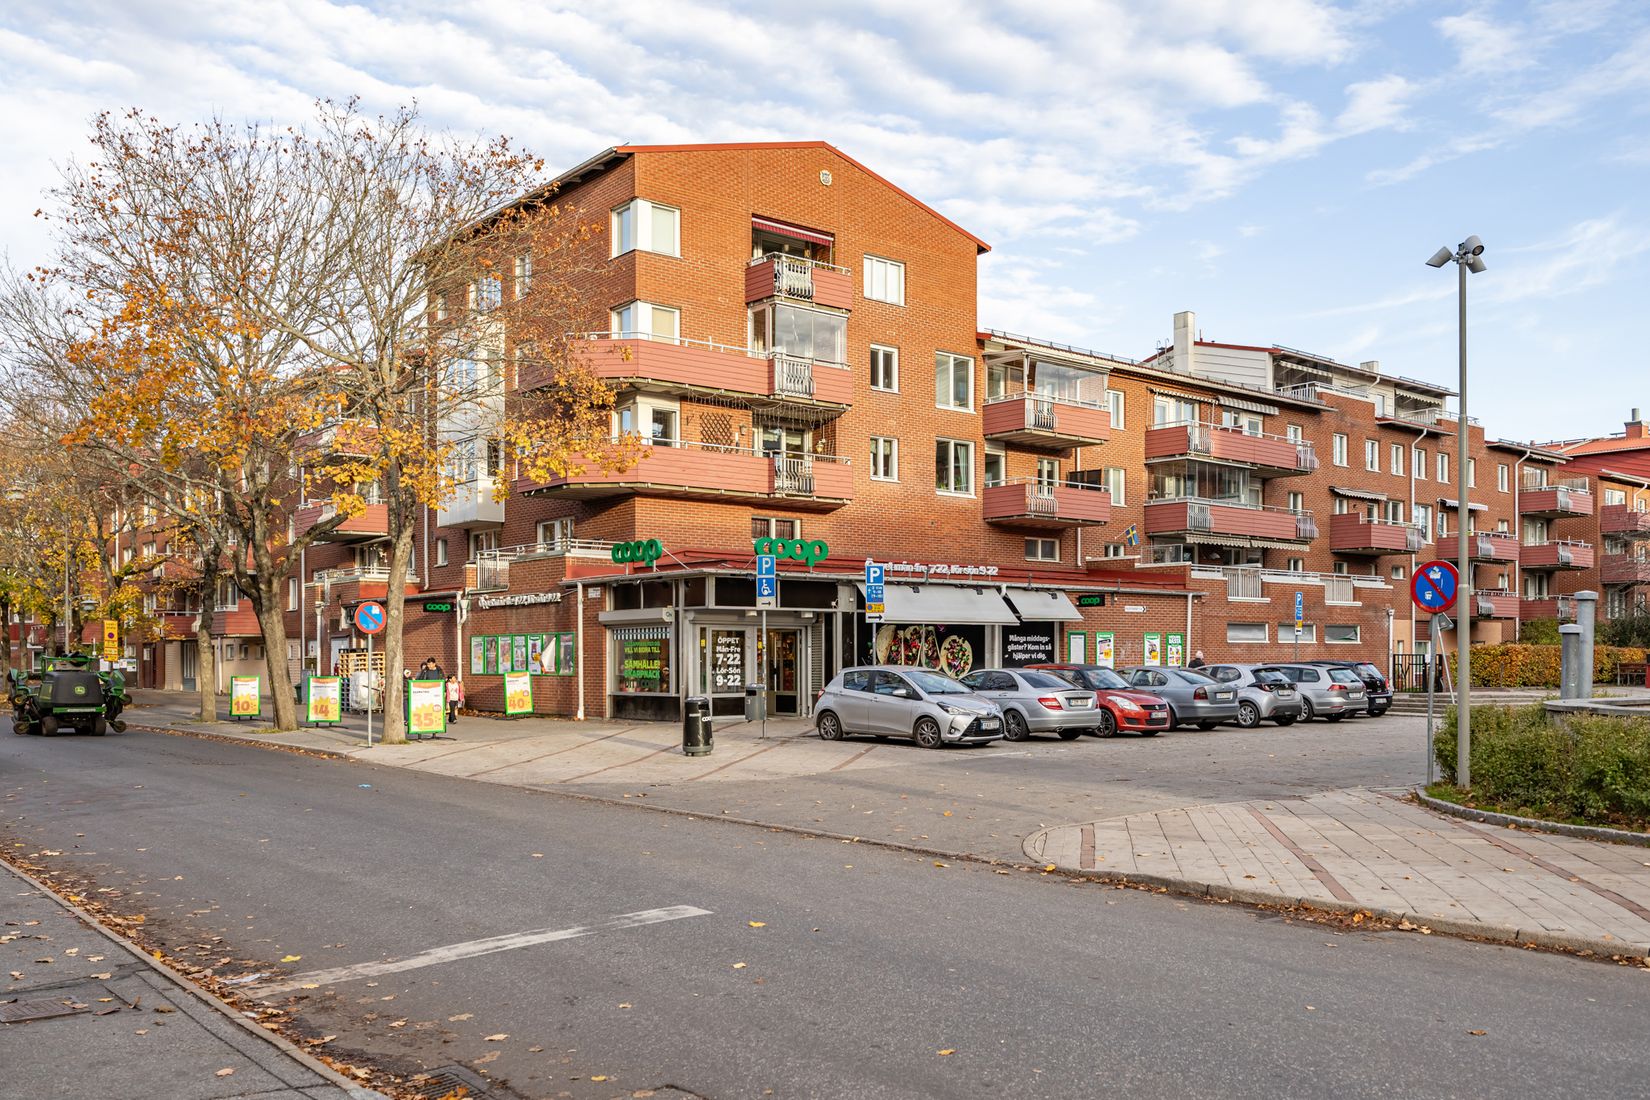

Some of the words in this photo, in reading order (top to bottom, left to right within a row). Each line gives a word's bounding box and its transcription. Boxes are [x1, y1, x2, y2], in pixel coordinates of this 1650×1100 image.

[612, 539, 662, 566] coop
[754, 537, 829, 567] coop
[762, 557, 772, 574] P
[870, 567, 881, 583] P
[426, 603, 451, 612] coop
[1081, 597, 1100, 605] coop
[717, 636, 740, 644] ÖPPET
[716, 653, 741, 665] 7-22
[716, 674, 741, 687] 9-22
